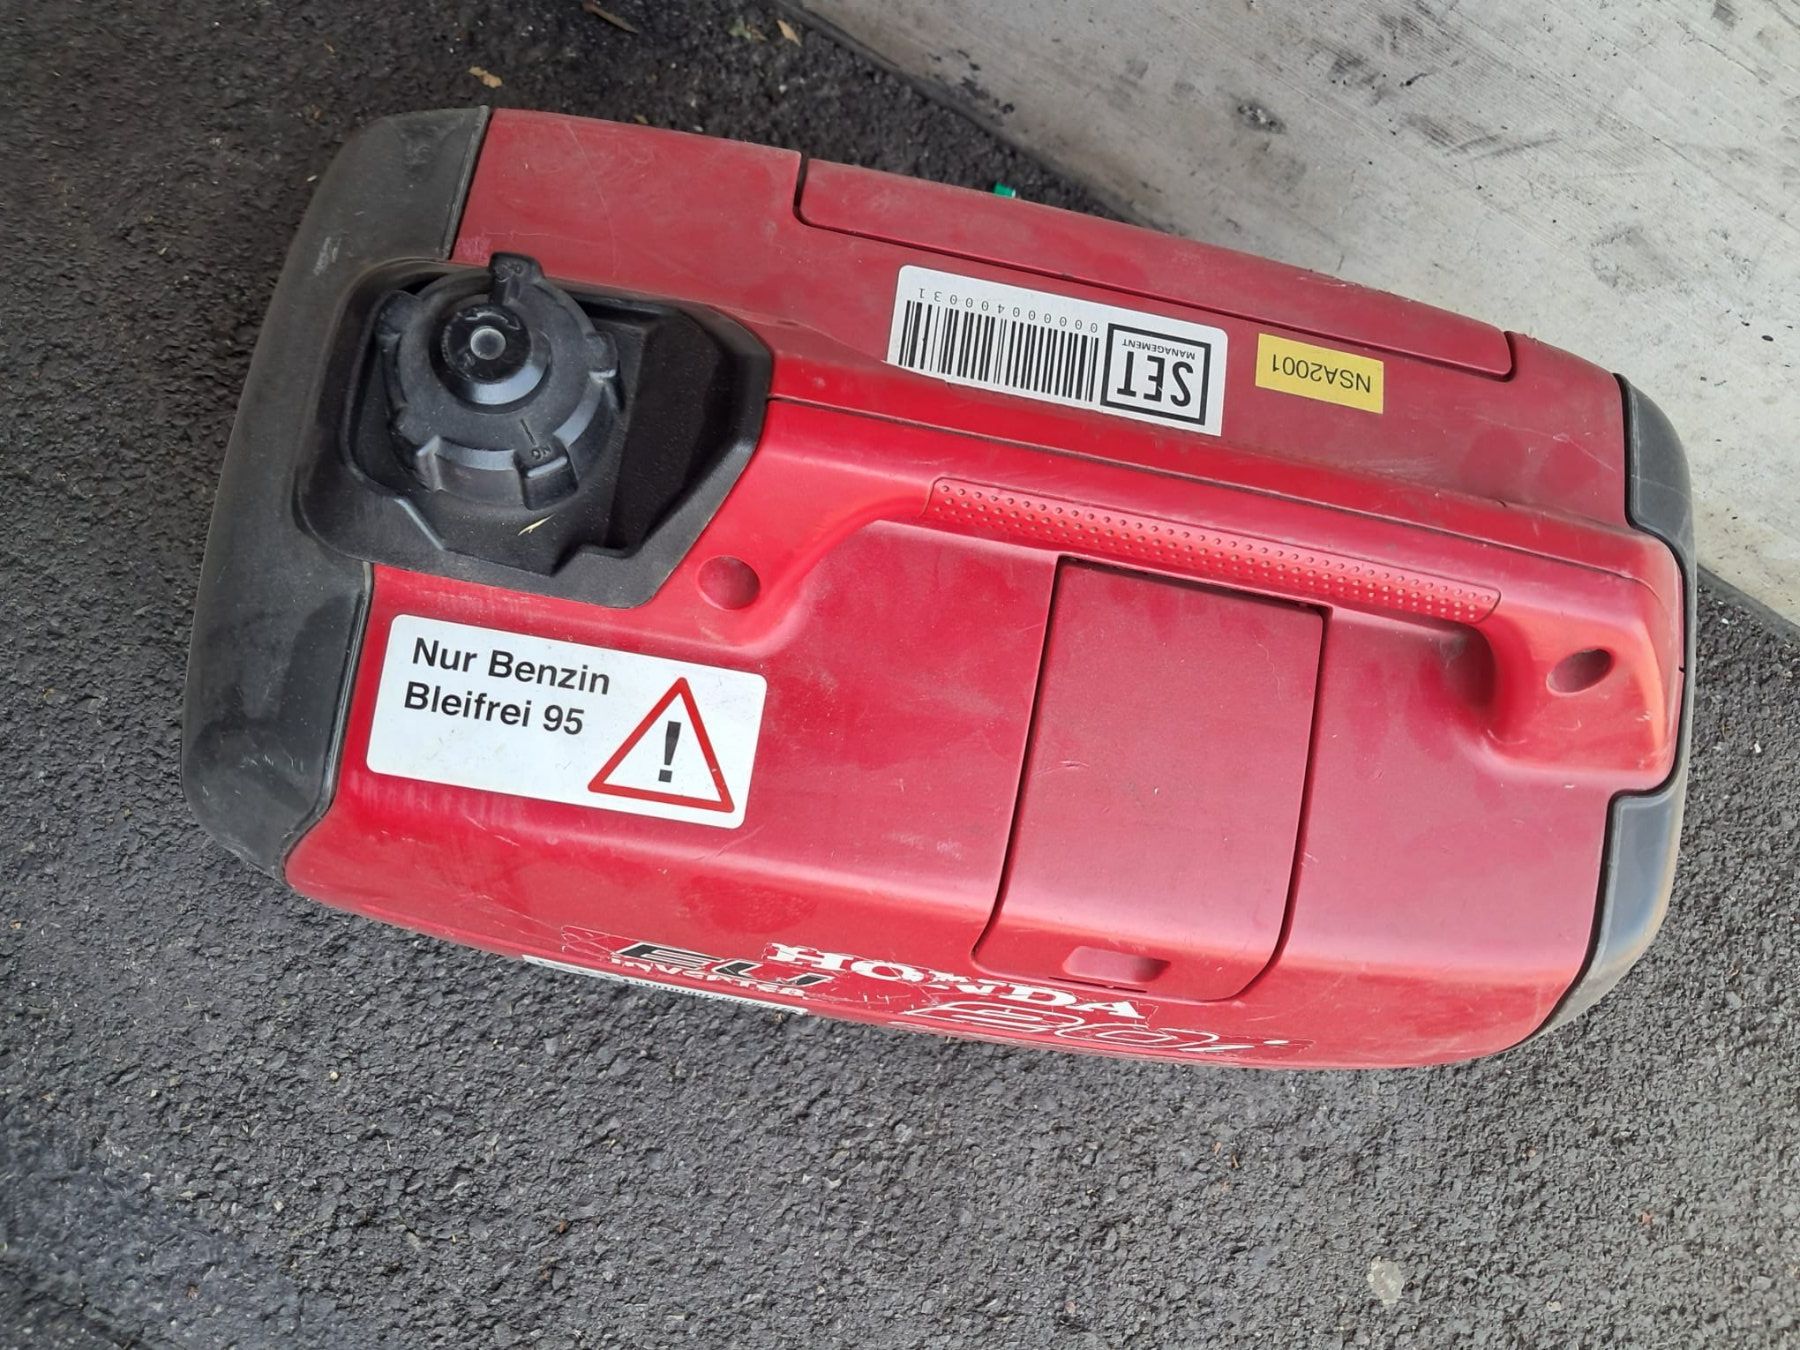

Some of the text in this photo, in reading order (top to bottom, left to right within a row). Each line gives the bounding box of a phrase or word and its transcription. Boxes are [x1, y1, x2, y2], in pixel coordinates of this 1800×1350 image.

[1121, 337, 1196, 361] MANAGEMENT
[1270, 353, 1373, 394] NSA2001
[1115, 351, 1195, 407] SET
[413, 637, 611, 695] Nur Benzin
[404, 681, 585, 735] Bleifrei 95
[765, 942, 1147, 1019] HONDA
